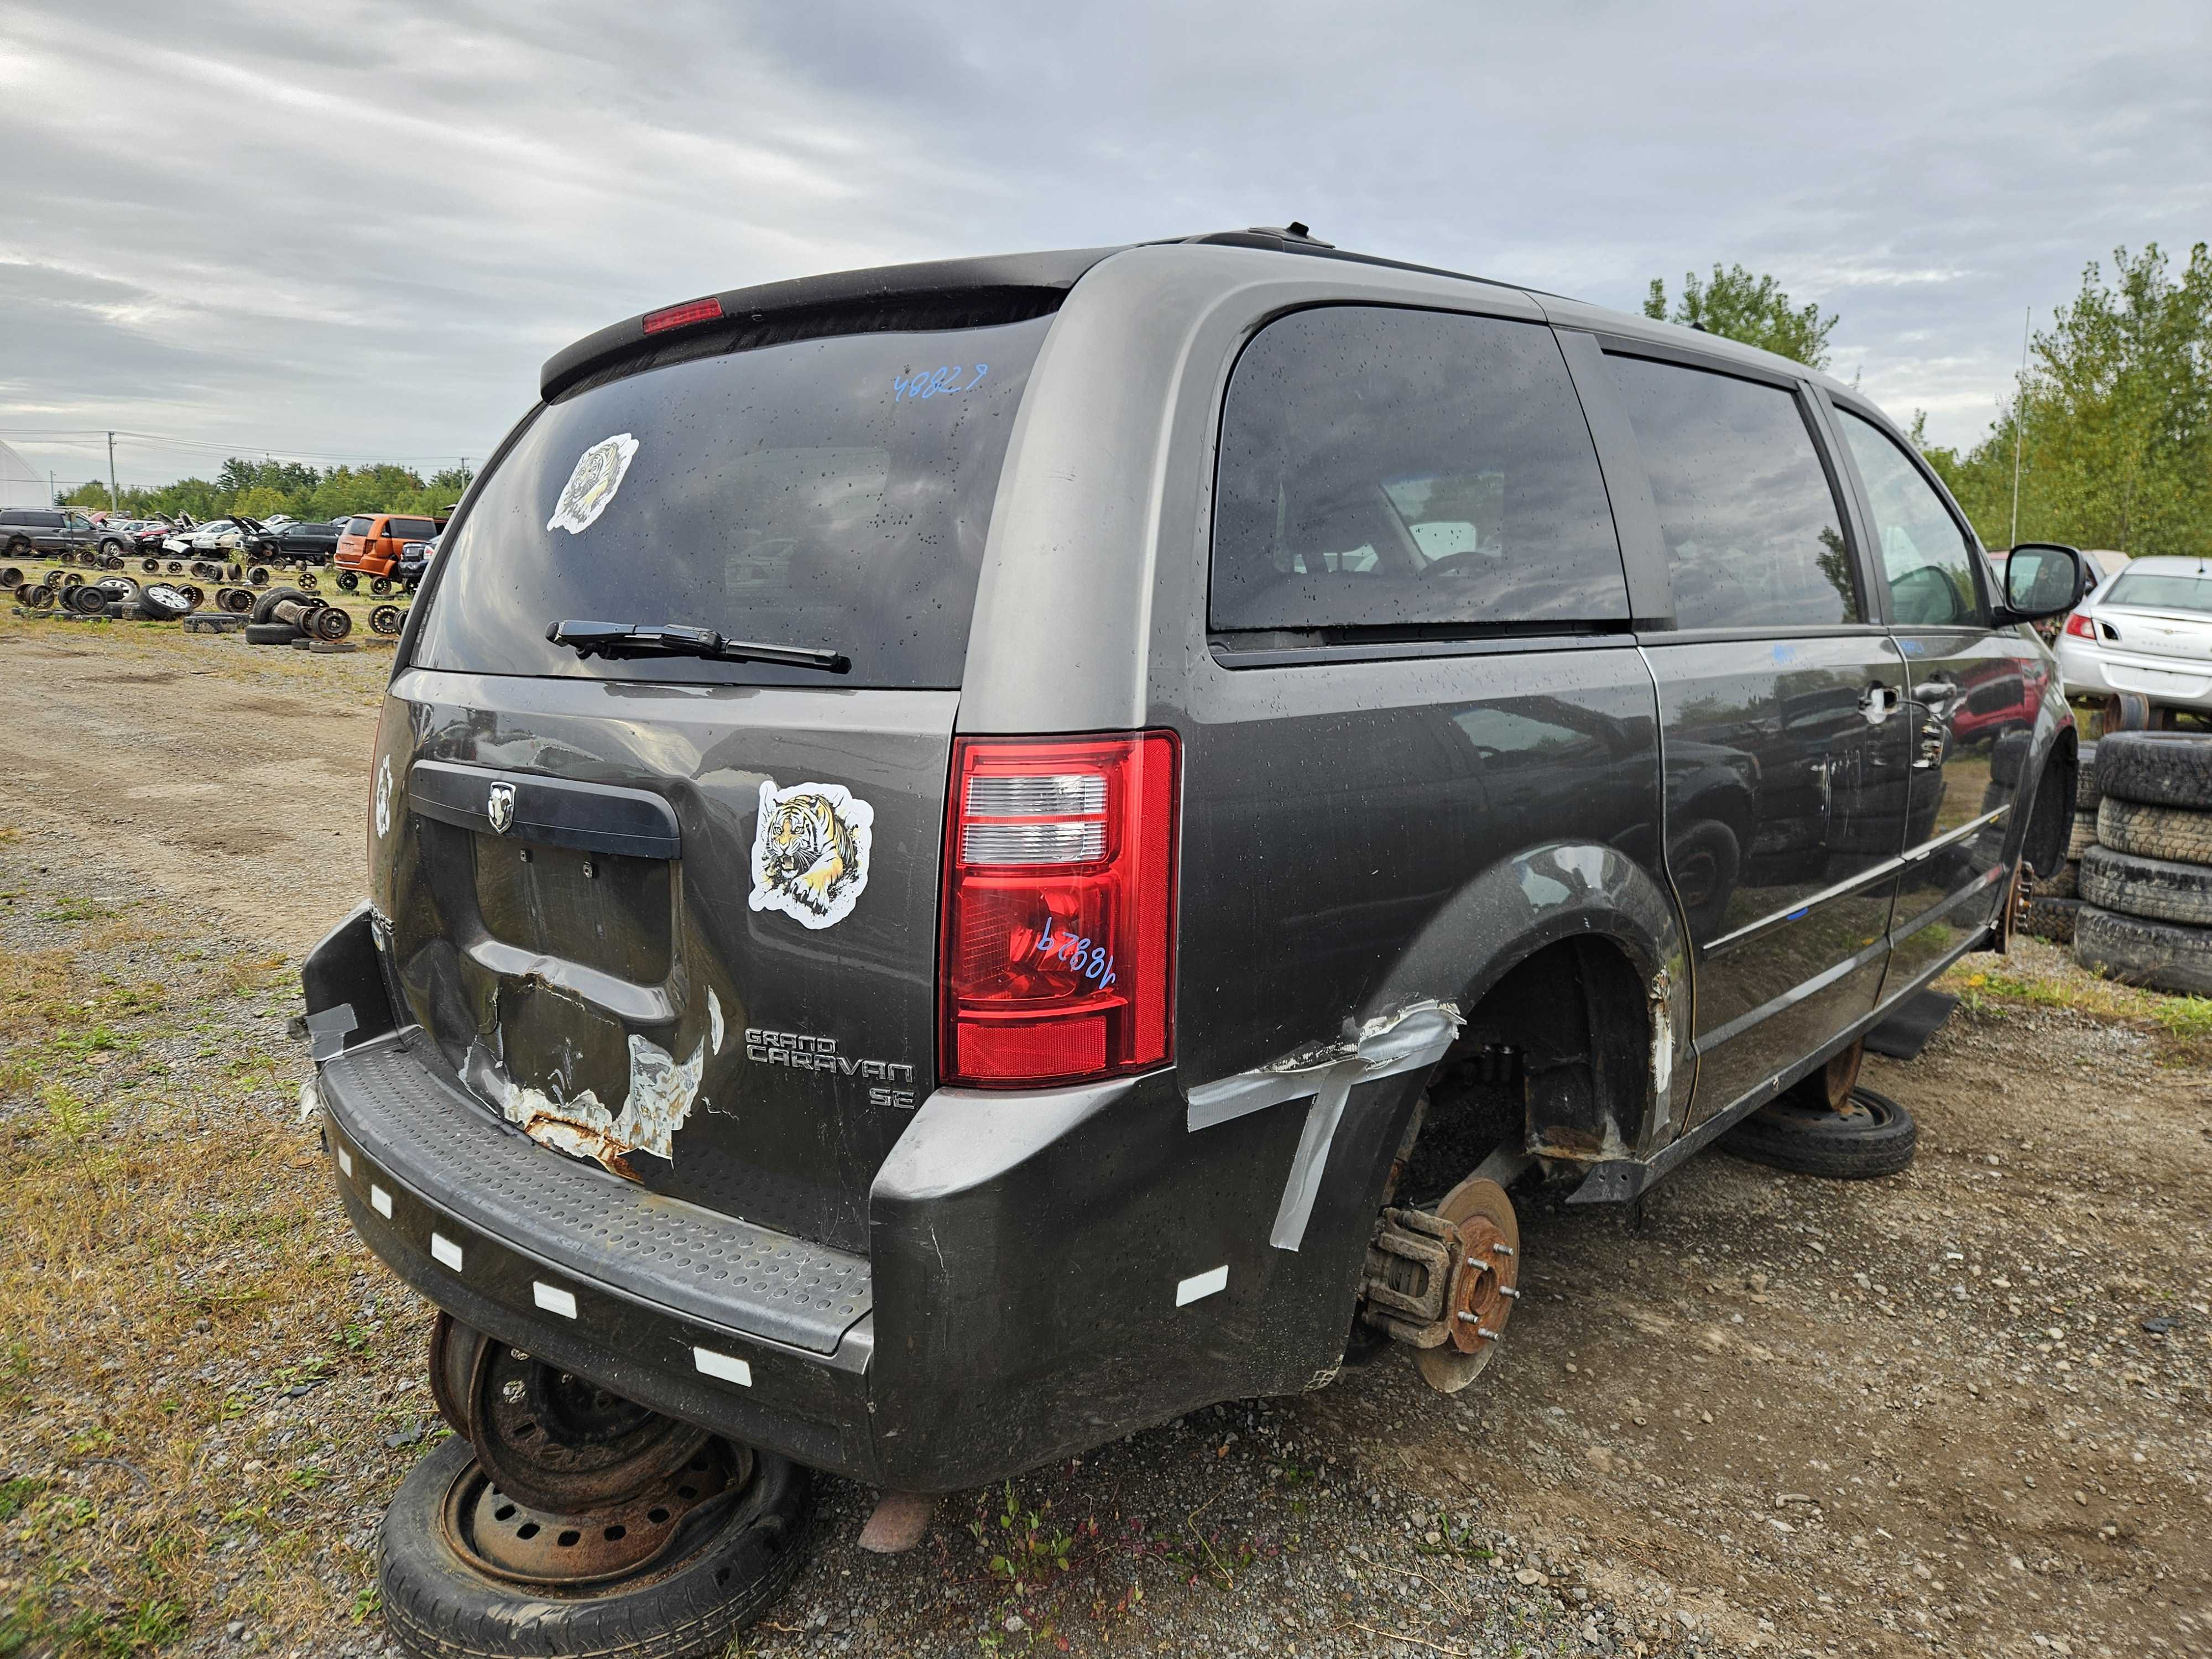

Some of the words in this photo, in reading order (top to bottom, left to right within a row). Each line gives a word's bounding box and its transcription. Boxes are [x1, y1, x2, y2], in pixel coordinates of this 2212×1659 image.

[745, 1027, 837, 1054] GRAND
[747, 1044, 913, 1083] CARAVAN
[869, 1087, 915, 1109] SE
